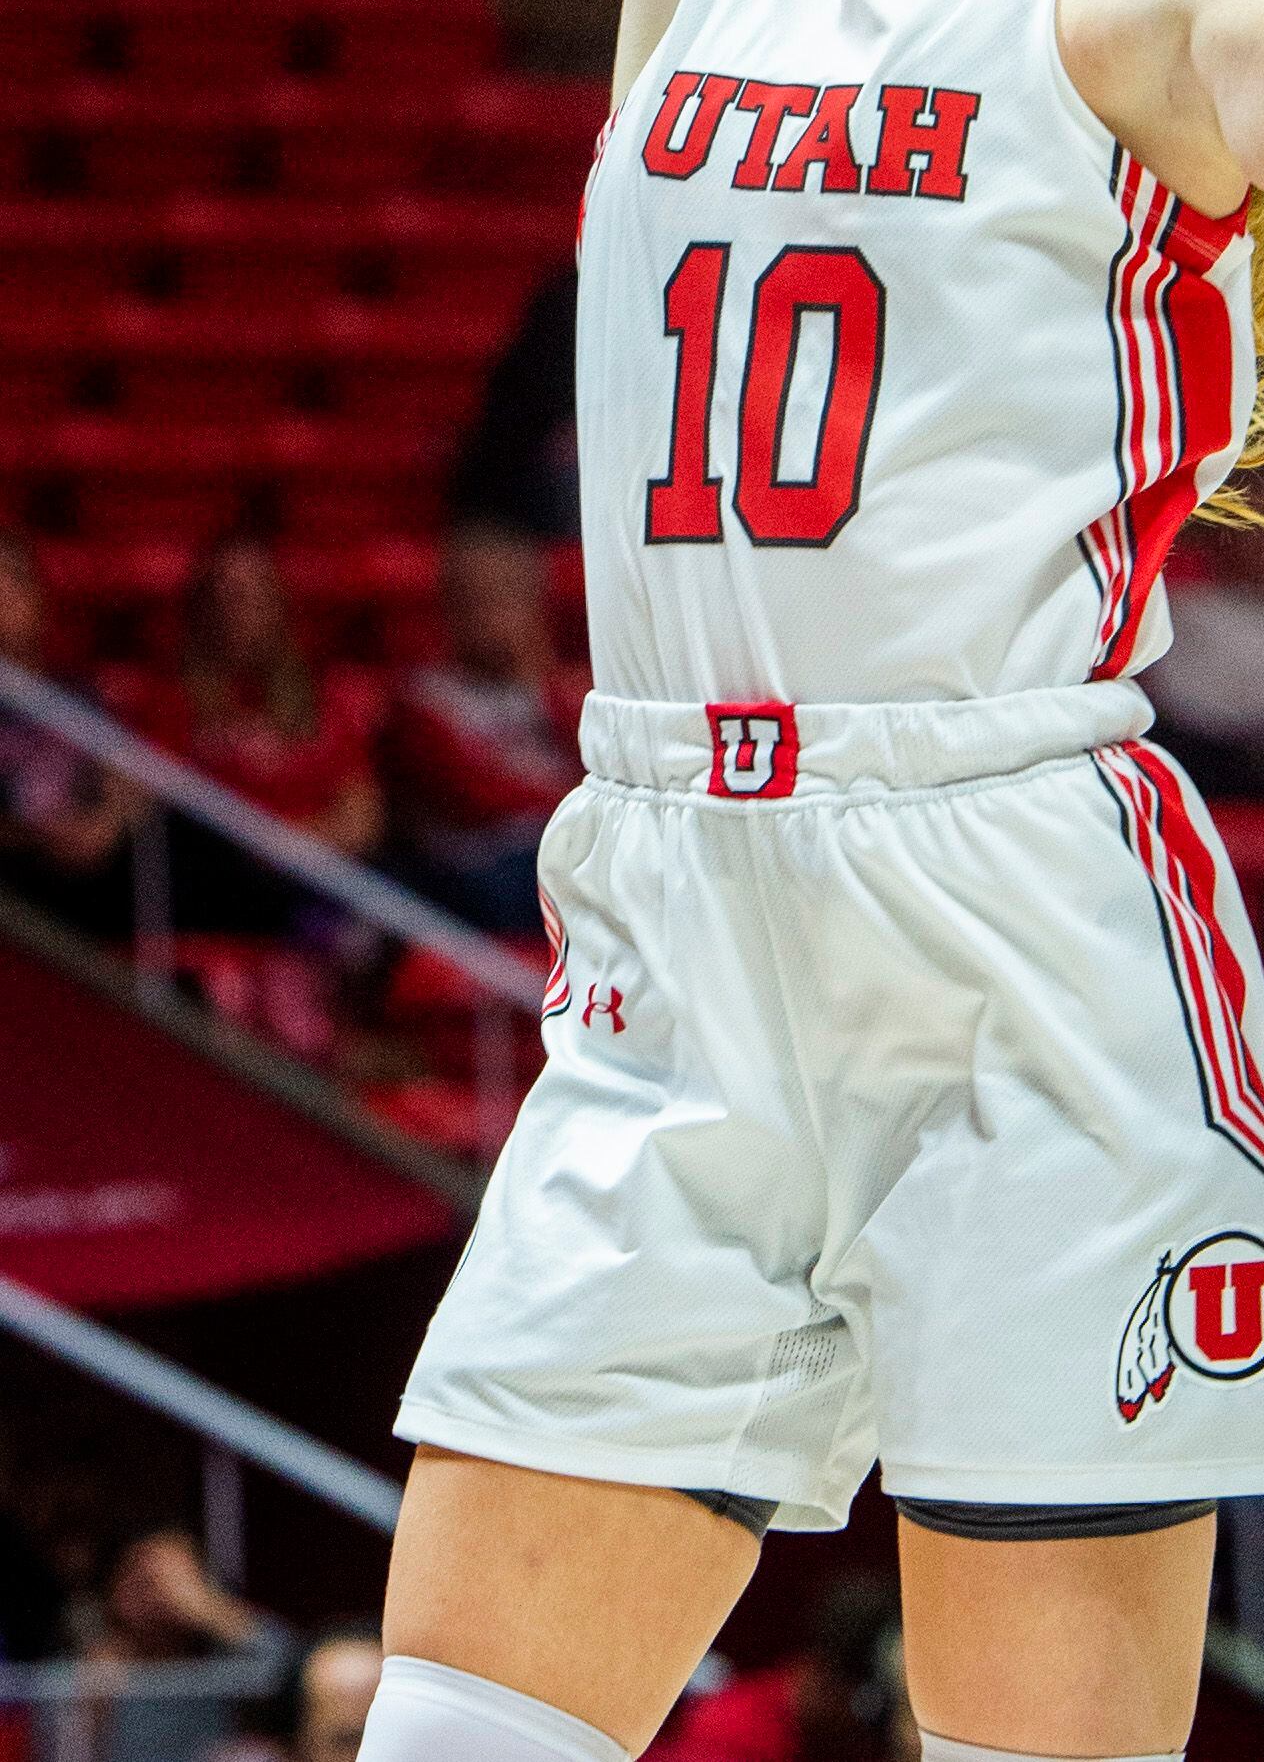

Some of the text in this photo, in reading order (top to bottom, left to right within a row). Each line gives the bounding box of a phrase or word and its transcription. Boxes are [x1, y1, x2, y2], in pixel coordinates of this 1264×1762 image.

[641, 70, 982, 202] UTAH
[644, 241, 886, 549] 10
[716, 715, 781, 794] U
